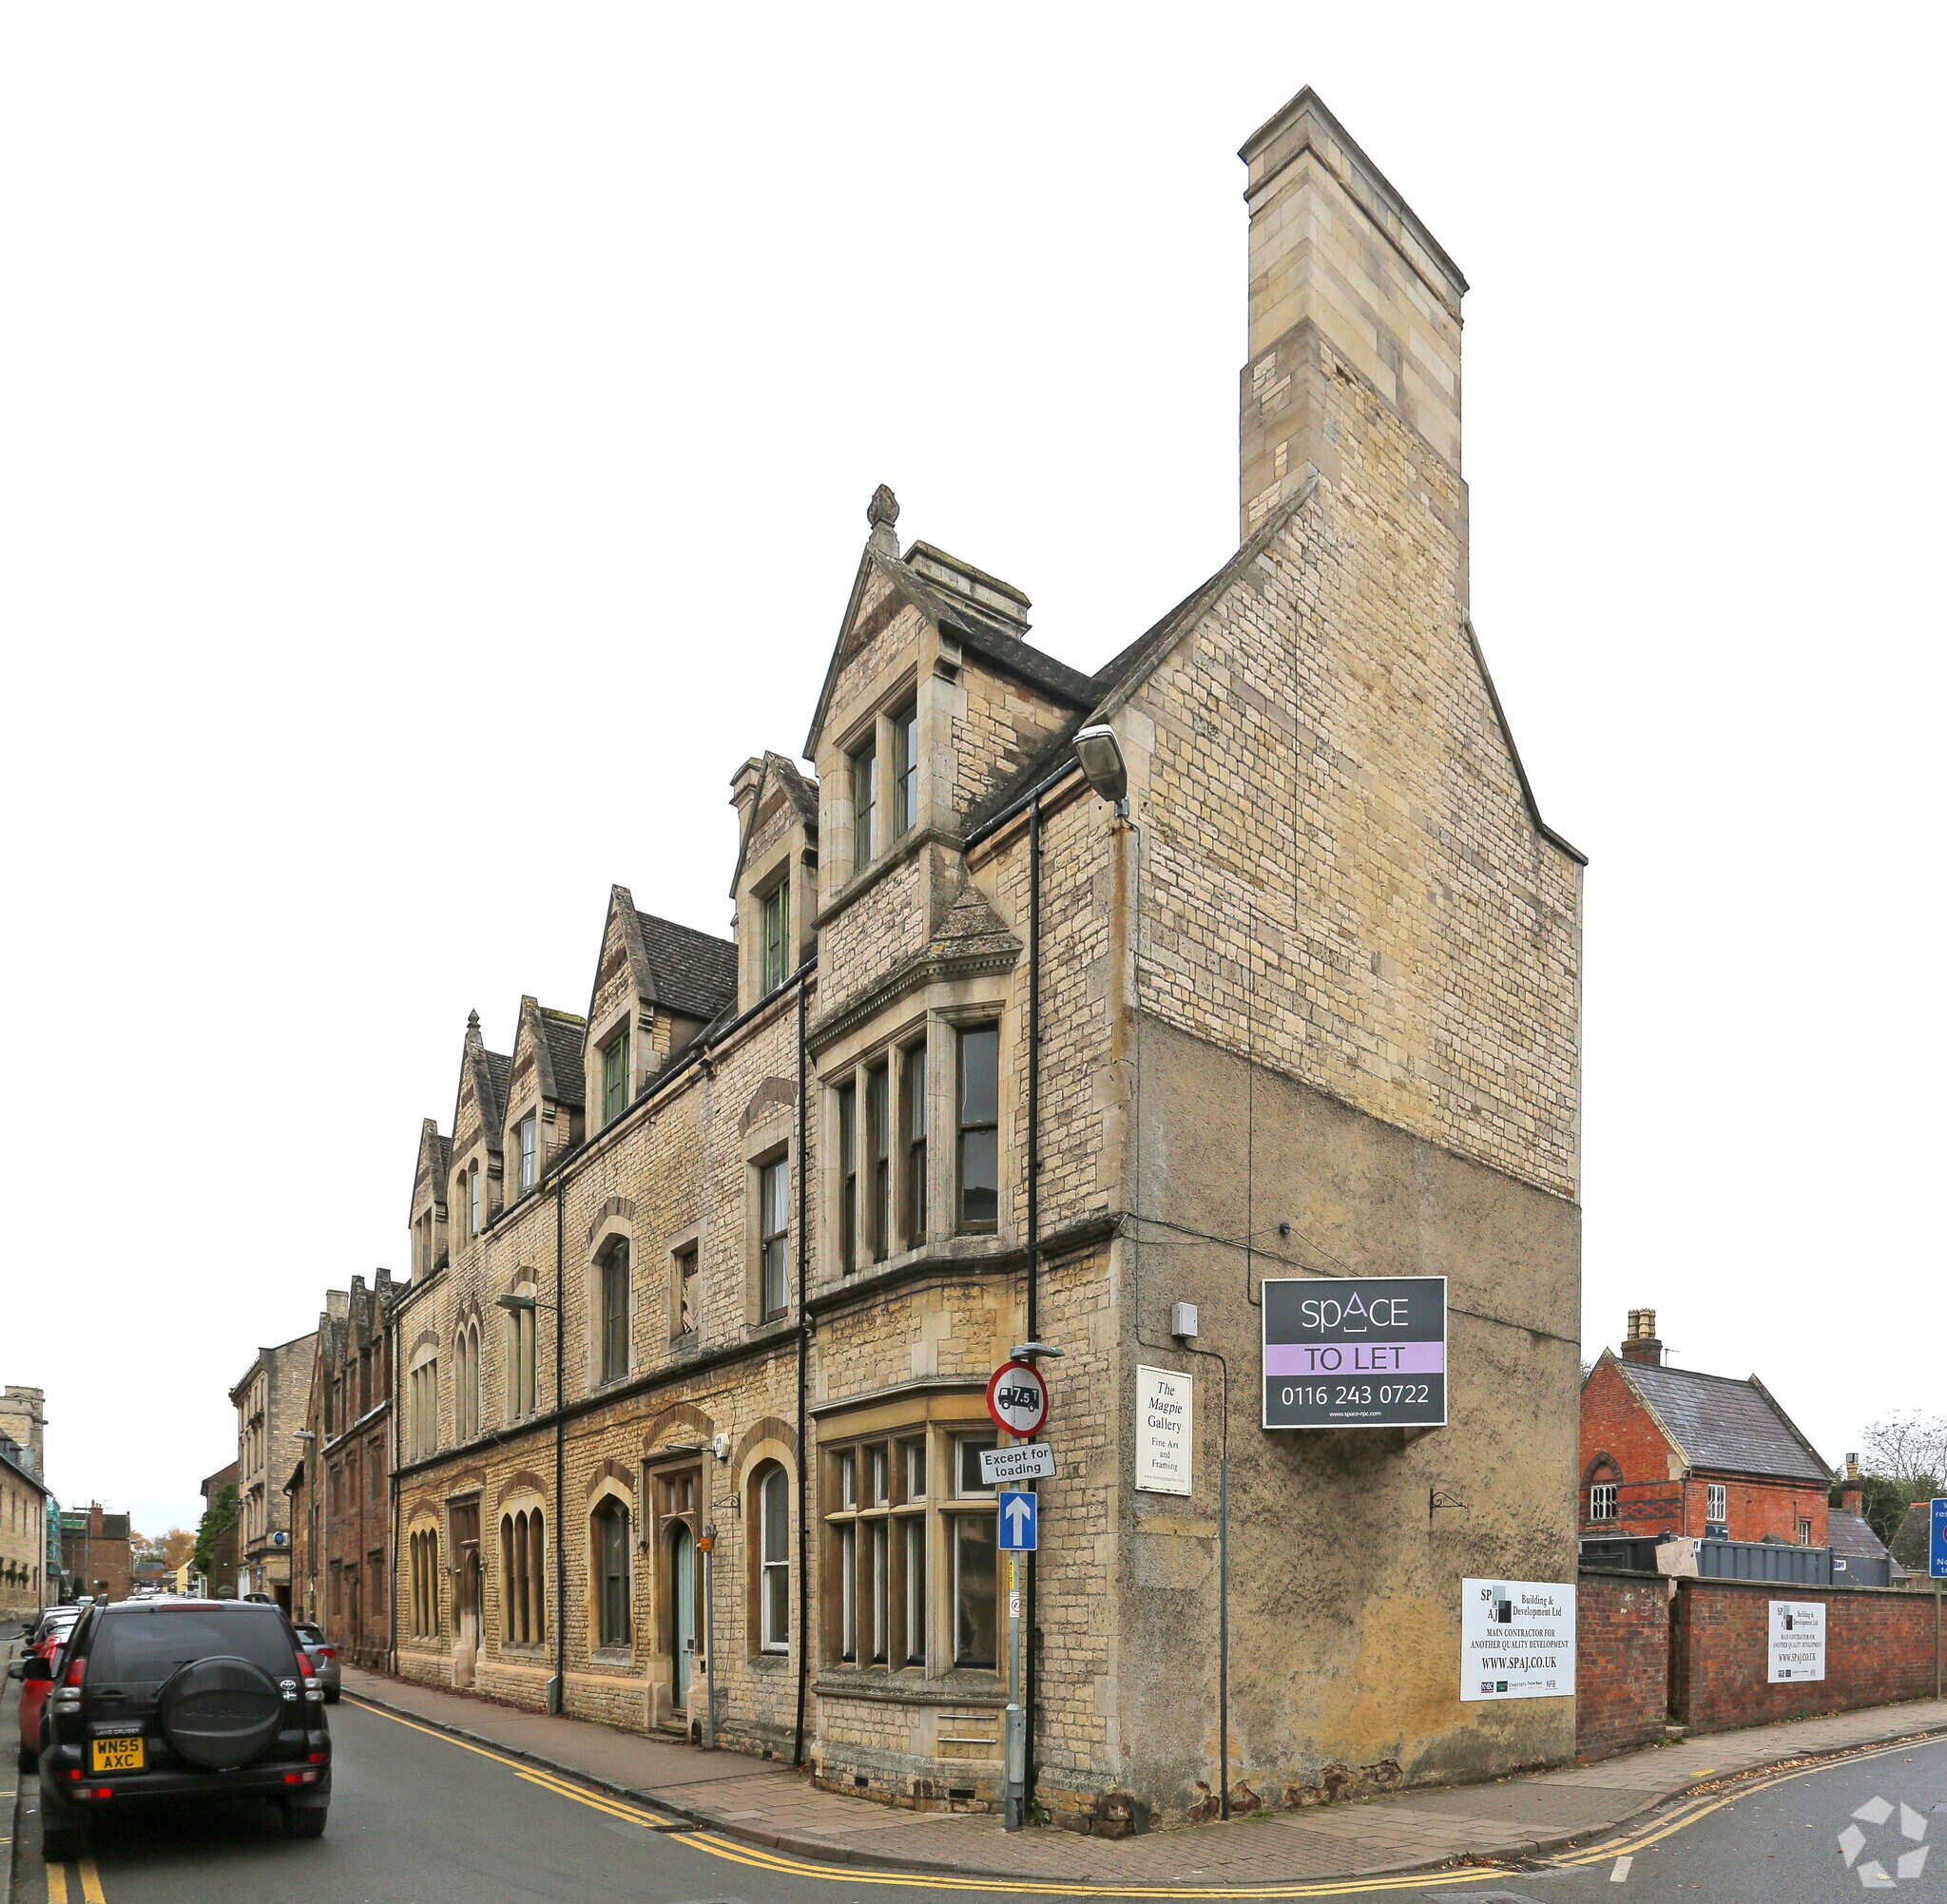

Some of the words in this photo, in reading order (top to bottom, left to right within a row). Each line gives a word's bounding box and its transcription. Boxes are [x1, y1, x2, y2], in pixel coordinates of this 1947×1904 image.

[1304, 1348, 1342, 1371] TO
[1355, 1346, 1405, 1370] LET
[1158, 1381, 1175, 1395] The
[1013, 1388, 1030, 1403] 7.5
[1032, 1390, 1038, 1400] T
[1282, 1387, 1327, 1406] 0116
[1335, 1386, 1372, 1404] 243
[1379, 1384, 1429, 1403] 0722
[1148, 1396, 1182, 1414] Magpie
[1148, 1415, 1182, 1433] Gallery
[1151, 1437, 1166, 1447] Fine
[1167, 1440, 1179, 1449] Art
[985, 1451, 1028, 1466] Except
[1031, 1449, 1049, 1459] for
[995, 1464, 1041, 1477] loading
[1152, 1459, 1178, 1471] Framing
[1481, 1589, 1492, 1601] SP
[1521, 1594, 1547, 1607] Building
[1548, 1596, 1553, 1606] &
[1488, 1609, 1498, 1622] AJ
[1513, 1606, 1552, 1619] Development
[1552, 1607, 1562, 1616] Ltd
[1487, 1628, 1503, 1637] MAIN
[1504, 1628, 1544, 1637] CONTRACTOR
[1502, 1641, 1528, 1651] QUALITY
[1482, 1656, 1556, 1672] WWW.SPAJ.CO.UK
[98, 1740, 139, 1754] WN55
[104, 1755, 134, 1768] AXC
